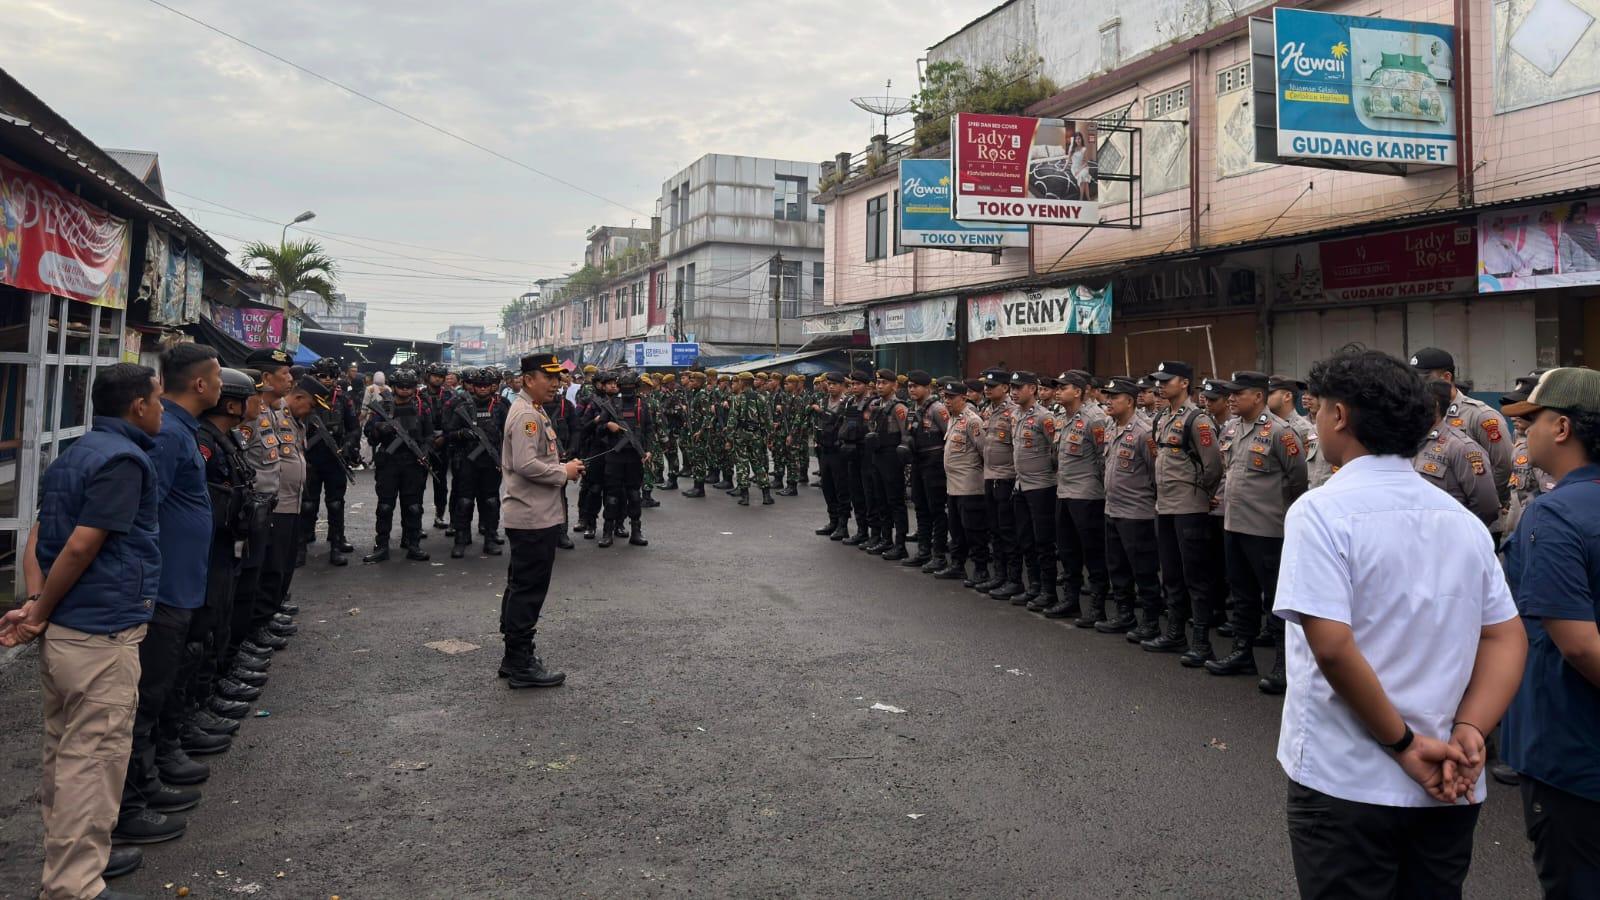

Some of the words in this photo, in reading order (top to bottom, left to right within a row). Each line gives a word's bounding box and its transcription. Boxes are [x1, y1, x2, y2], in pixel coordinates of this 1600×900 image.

[1281, 41, 1345, 76] Hawaii
[968, 128, 1007, 148] Lady
[978, 144, 1016, 161] Rose
[1293, 136, 1373, 157] GUDANG
[1377, 141, 1449, 161] KARPET
[904, 177, 948, 198] Hawaii
[978, 201, 1024, 216] TOKO
[1027, 204, 1083, 219] YENNY
[920, 233, 956, 244] TOKO
[960, 234, 1004, 245] YENNY
[1405, 231, 1445, 252] Lady
[1415, 249, 1456, 266] Rose
[1147, 265, 1223, 301] ALISAN
[1342, 286, 1394, 299] GUDANG
[1398, 280, 1454, 295] KARPET
[241, 313, 266, 322] TOKO
[1003, 297, 1068, 326] YENNY
